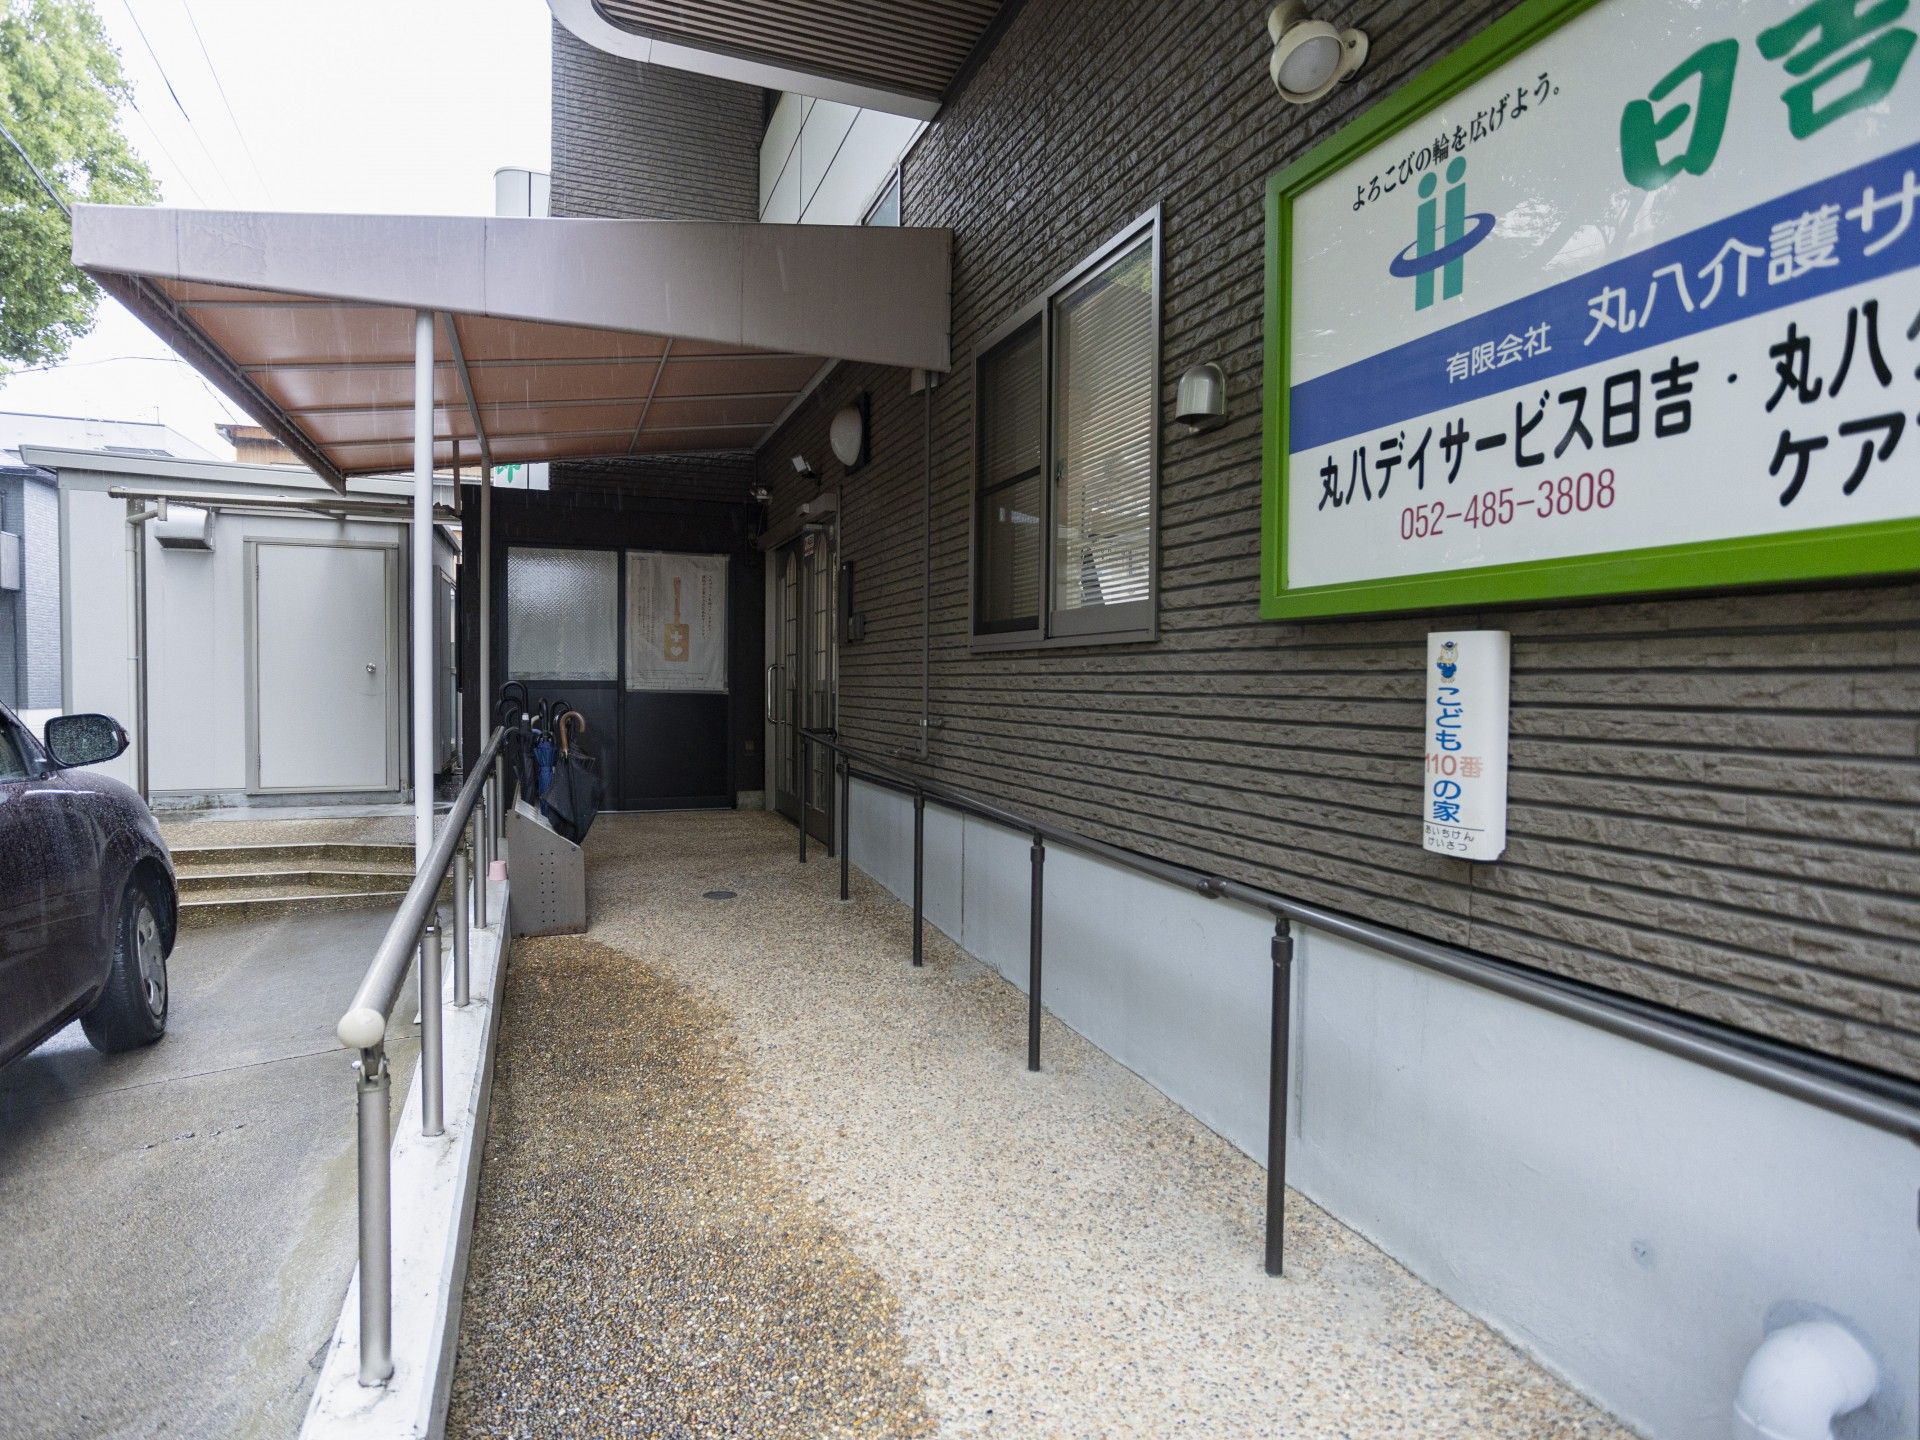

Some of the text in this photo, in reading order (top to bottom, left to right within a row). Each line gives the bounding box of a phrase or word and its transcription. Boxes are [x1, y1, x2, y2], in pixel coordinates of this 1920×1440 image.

[1353, 72, 1560, 211] よろこびの輪を広げよう。
[1620, 0, 1917, 190] 日吉
[1446, 322, 1552, 383] 有限会社
[1401, 468, 1616, 540] 052-485-3808
[1769, 411, 1920, 507] ケア
